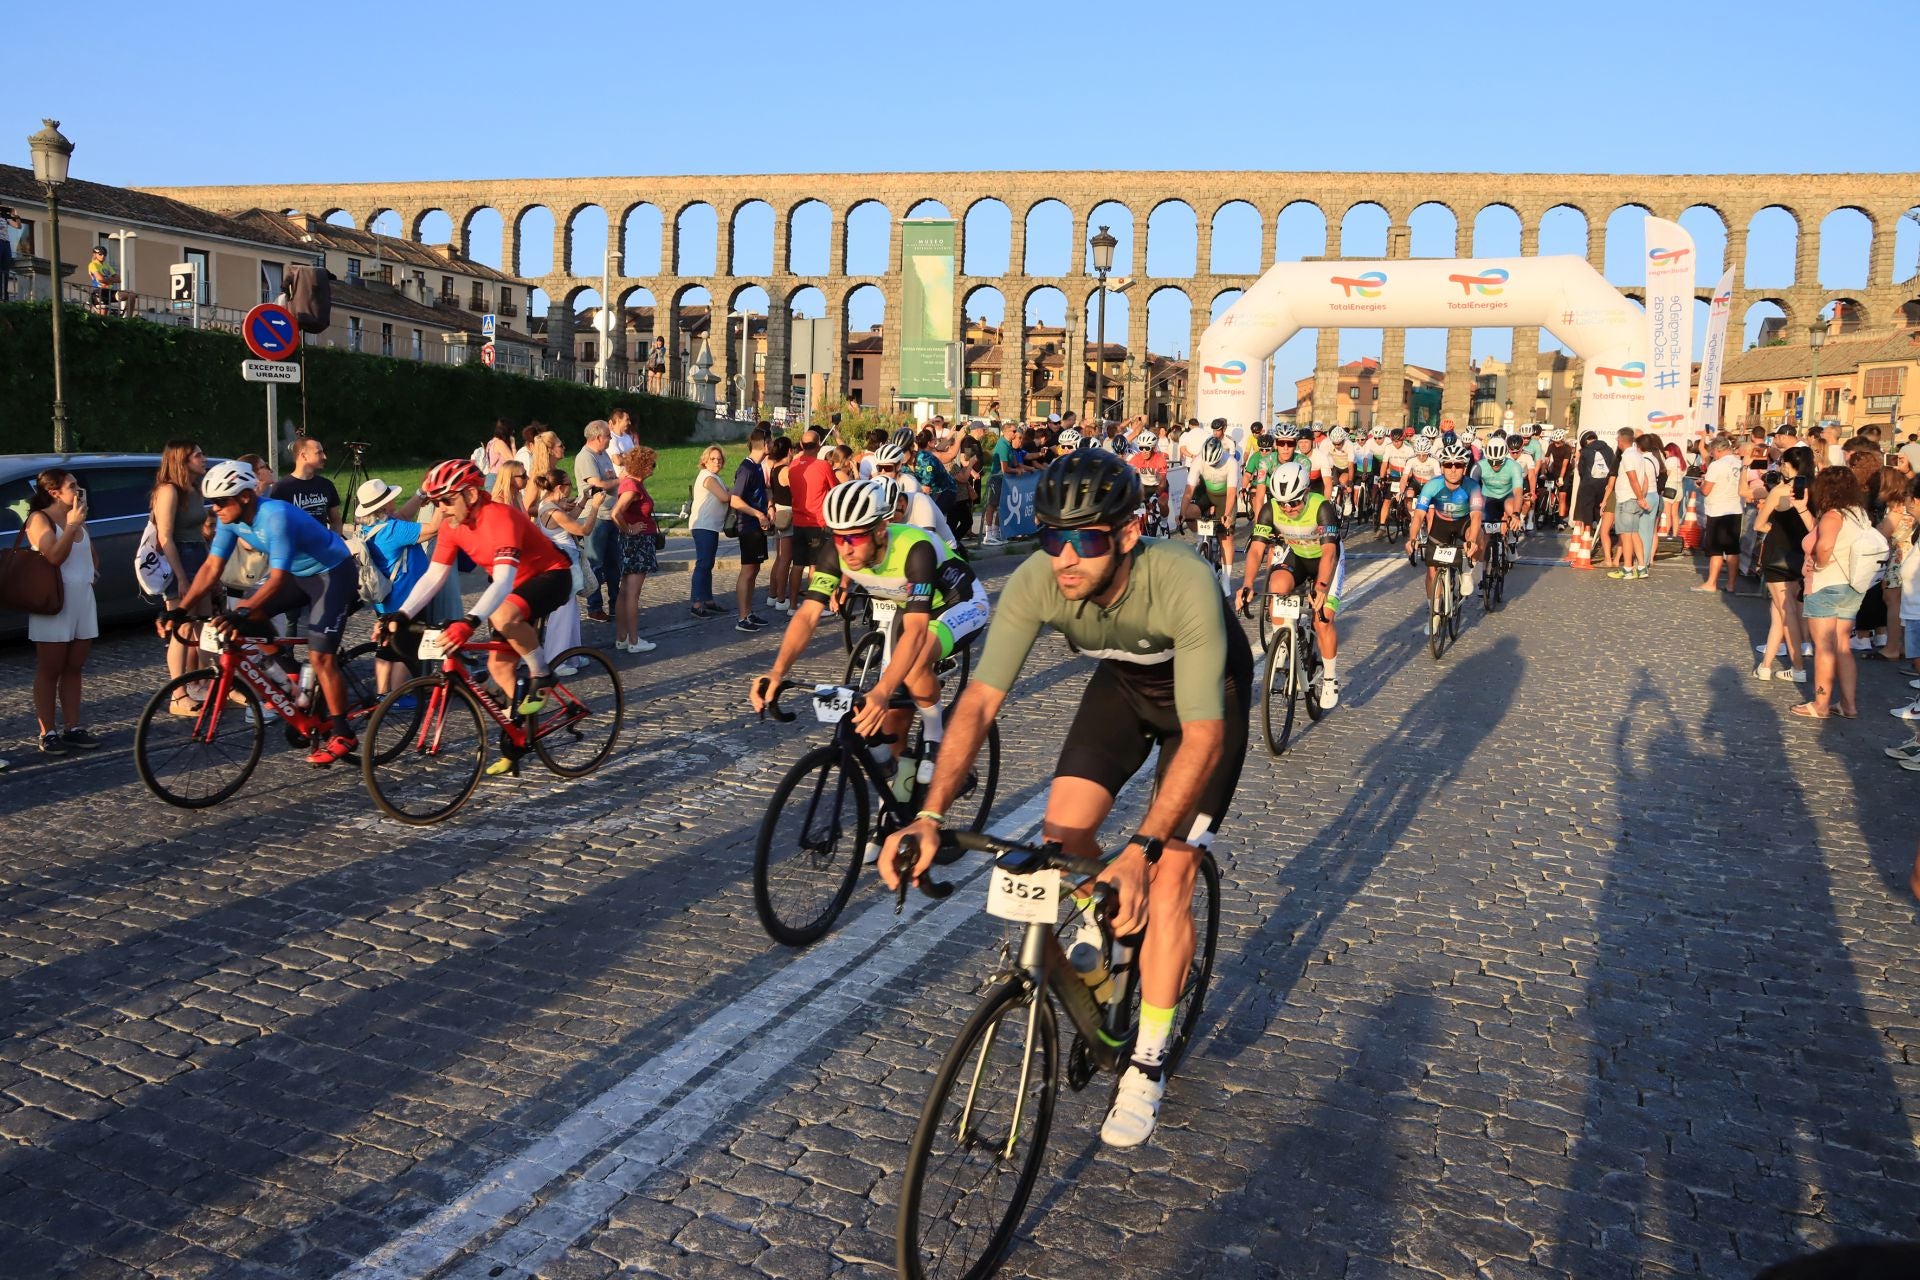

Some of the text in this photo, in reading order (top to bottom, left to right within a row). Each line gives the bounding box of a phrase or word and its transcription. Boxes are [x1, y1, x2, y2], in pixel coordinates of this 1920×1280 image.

[171, 274, 186, 300] P
[1329, 303, 1387, 312] TotalEnergies
[1448, 301, 1508, 310] TotalEnergies
[248, 363, 297, 373] EXCEPTO BUS
[1592, 392, 1646, 402] TotalEnergies
[875, 602, 896, 611] 1096
[1276, 599, 1298, 608] 1453
[1001, 876, 1046, 901] 352
